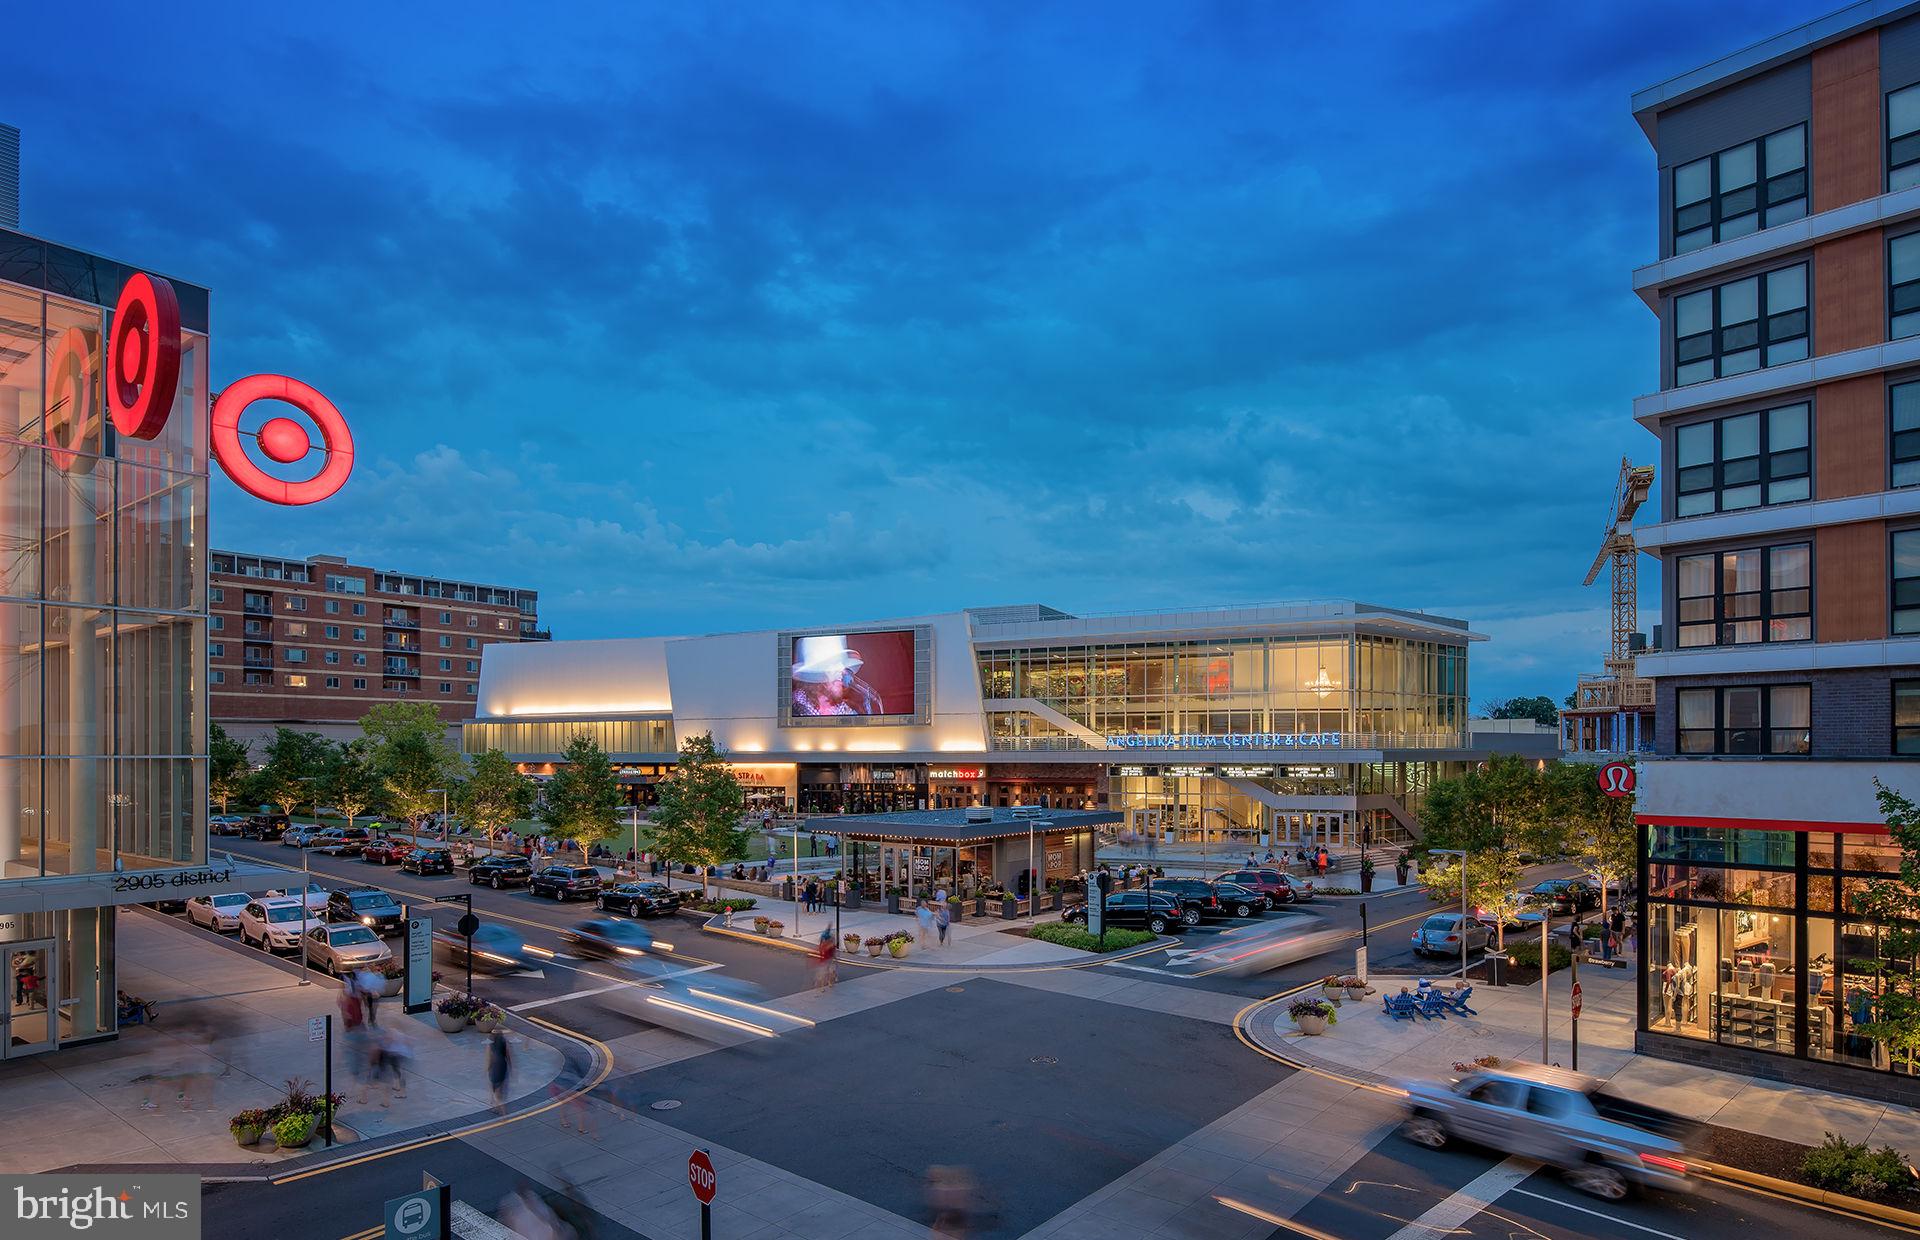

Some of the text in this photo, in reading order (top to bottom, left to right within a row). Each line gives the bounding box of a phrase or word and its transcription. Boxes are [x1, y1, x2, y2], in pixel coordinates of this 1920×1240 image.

[1106, 734, 1176, 747] ANGELIKA
[1183, 734, 1217, 746] FILM
[1223, 733, 1280, 746] CENTER
[1285, 734, 1294, 746] &
[738, 772, 765, 780] STRADA
[930, 770, 976, 778] matchbox
[115, 869, 231, 892] 2905 district
[1588, 957, 1615, 967] Strawberry
[690, 1163, 715, 1190] STOP
